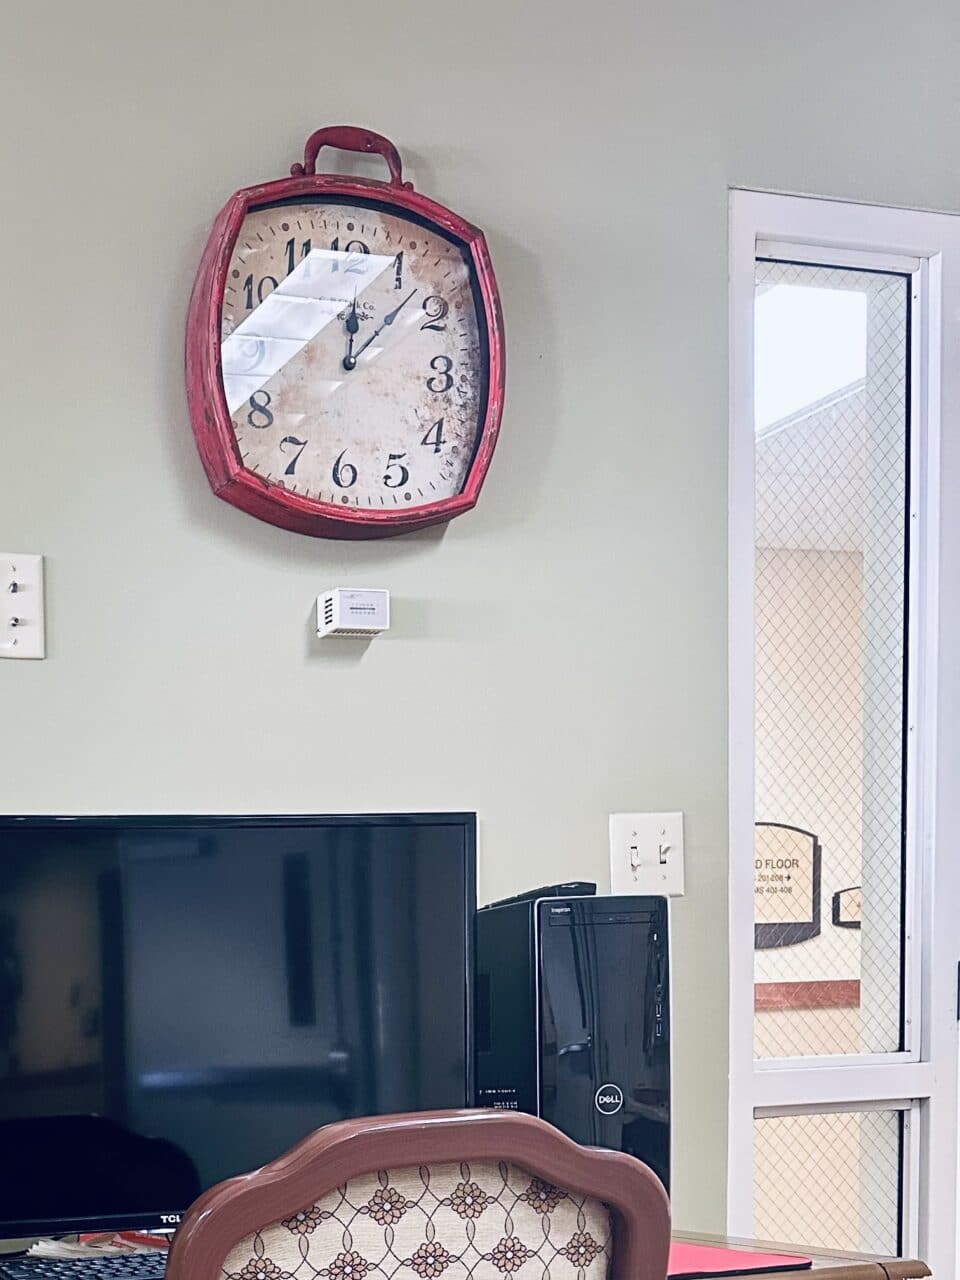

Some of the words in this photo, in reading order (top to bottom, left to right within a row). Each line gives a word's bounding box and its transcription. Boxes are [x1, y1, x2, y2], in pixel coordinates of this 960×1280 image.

[393, 251, 403, 290] 1
[420, 295, 449, 331] 2
[426, 355, 453, 393] 3
[247, 390, 274, 429] 8
[421, 417, 446, 453] 4
[279, 436, 308, 475] 7
[332, 448, 358, 488] 6
[383, 453, 409, 488] 5
[765, 859, 799, 869] FLOOR
[599, 1095, 621, 1104] DELL
[160, 1215, 181, 1224] TCL
